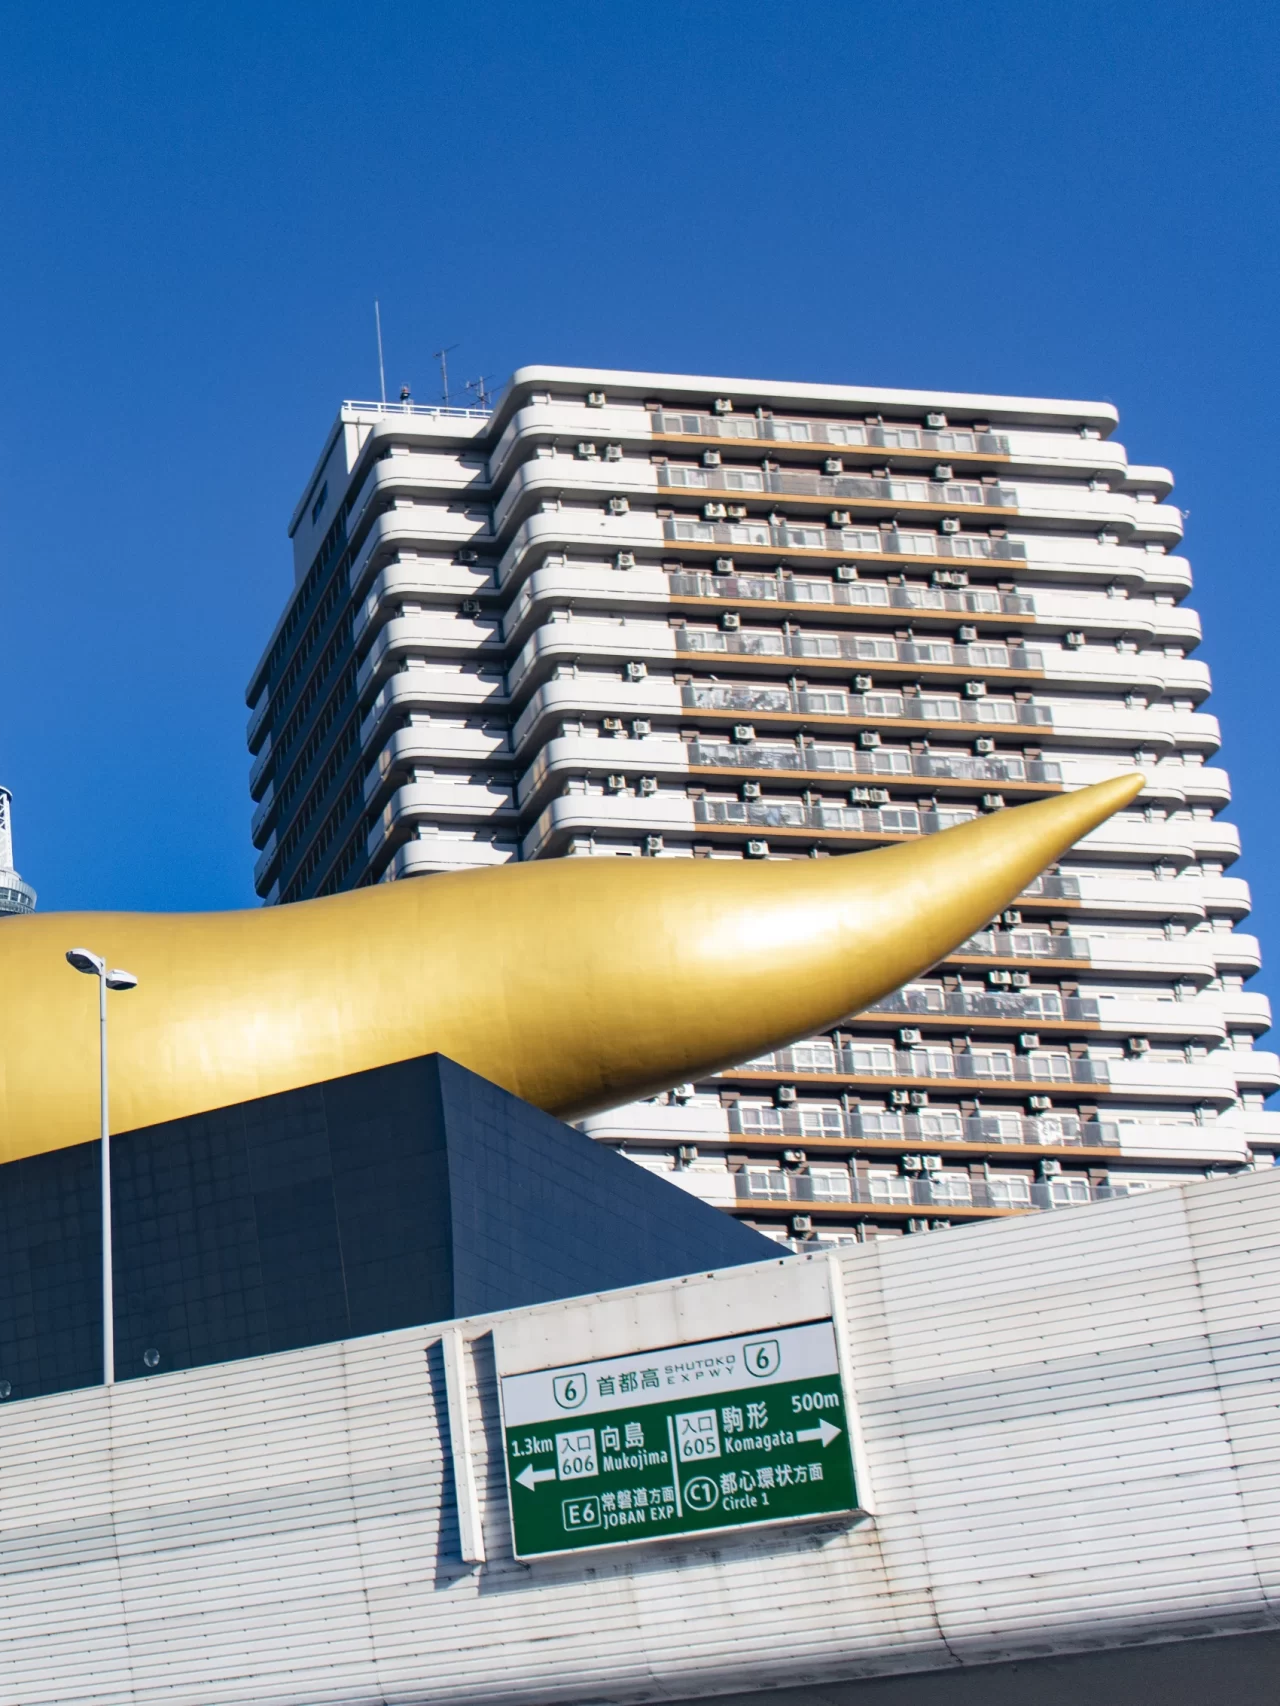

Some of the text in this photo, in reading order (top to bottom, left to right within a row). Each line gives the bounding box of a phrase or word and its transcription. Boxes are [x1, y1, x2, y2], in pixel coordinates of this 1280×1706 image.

[664, 1355, 736, 1374] SHUTOKO
[756, 1346, 770, 1369] 6
[564, 1380, 577, 1401] 6
[597, 1368, 660, 1397] 首都高
[791, 1392, 840, 1414] 500m
[682, 1416, 714, 1436] 入口
[722, 1401, 768, 1434] 駒形
[511, 1436, 554, 1457] 1.3km
[560, 1435, 591, 1454] 入口
[600, 1422, 644, 1453] 向島
[683, 1436, 716, 1457] 605
[724, 1430, 794, 1454] Komagata
[562, 1456, 594, 1475] 606
[603, 1450, 668, 1472] Mukojima
[720, 1462, 824, 1495] 都心環状方面
[690, 1483, 712, 1503] C1
[722, 1492, 770, 1511] Circle 1
[569, 1503, 595, 1524] E6
[603, 1506, 674, 1530] JOBAN EXP
